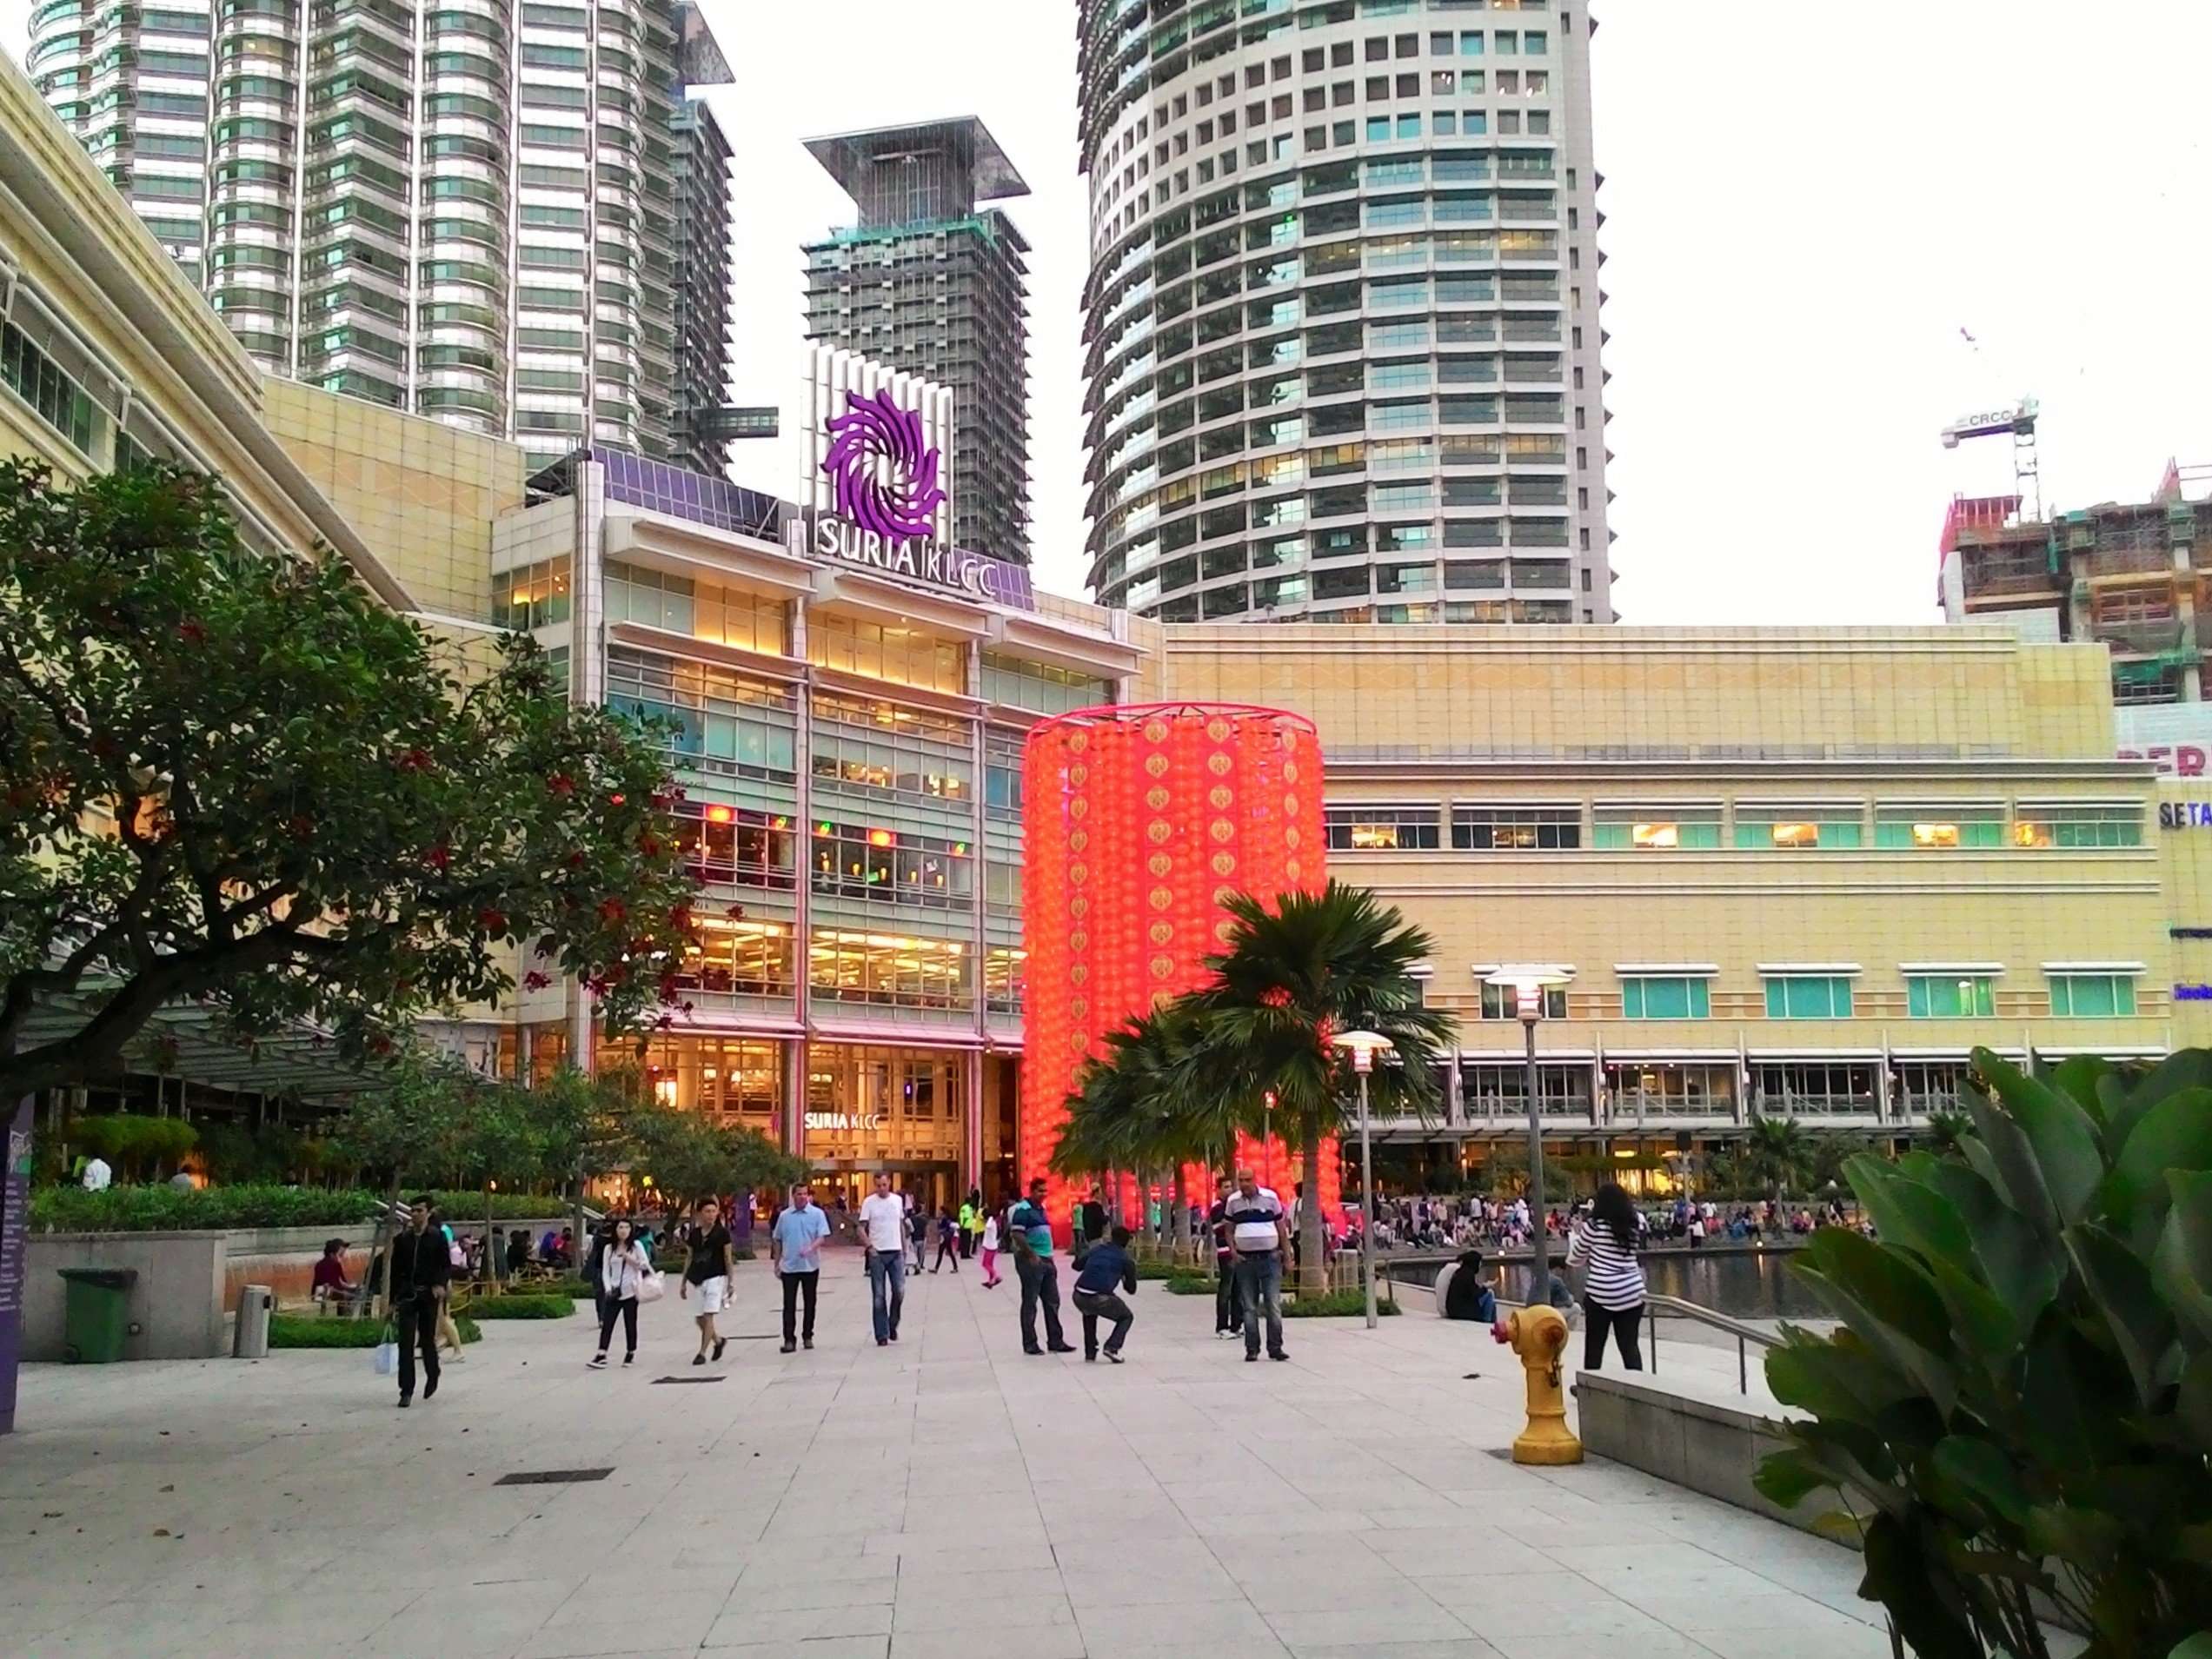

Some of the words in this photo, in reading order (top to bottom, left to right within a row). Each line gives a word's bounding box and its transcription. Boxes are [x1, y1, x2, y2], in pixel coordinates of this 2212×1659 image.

[818, 518, 916, 575] SURIA
[927, 547, 996, 595] KLCC
[805, 1112, 848, 1129] SURIA
[851, 1113, 880, 1129] KLCC
